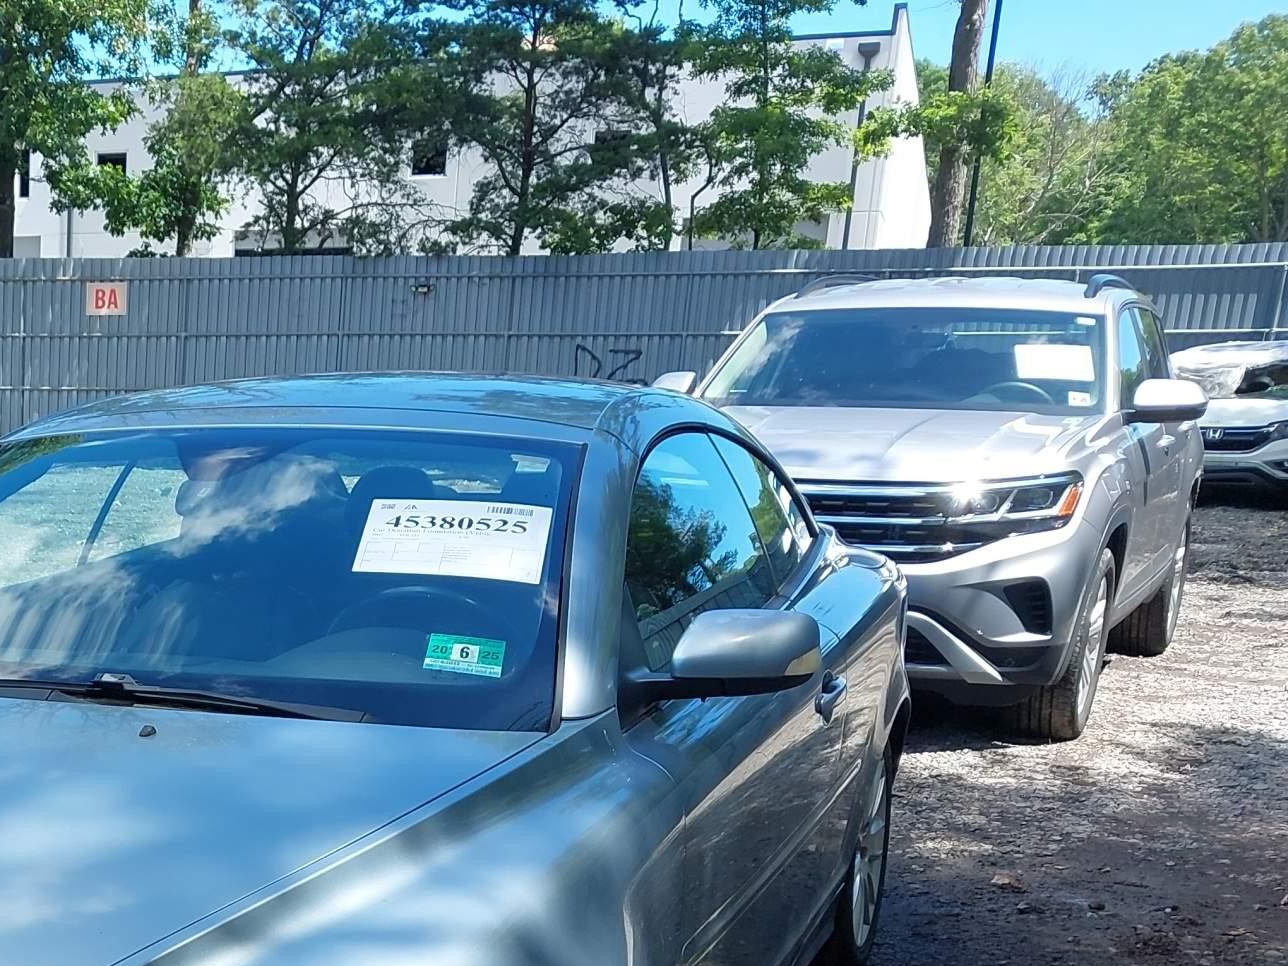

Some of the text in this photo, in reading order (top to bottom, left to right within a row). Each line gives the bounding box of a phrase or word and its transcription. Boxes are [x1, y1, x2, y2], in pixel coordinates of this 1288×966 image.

[94, 287, 119, 310] BA
[385, 514, 529, 535] 45380525
[431, 644, 500, 661] 20 6 25
